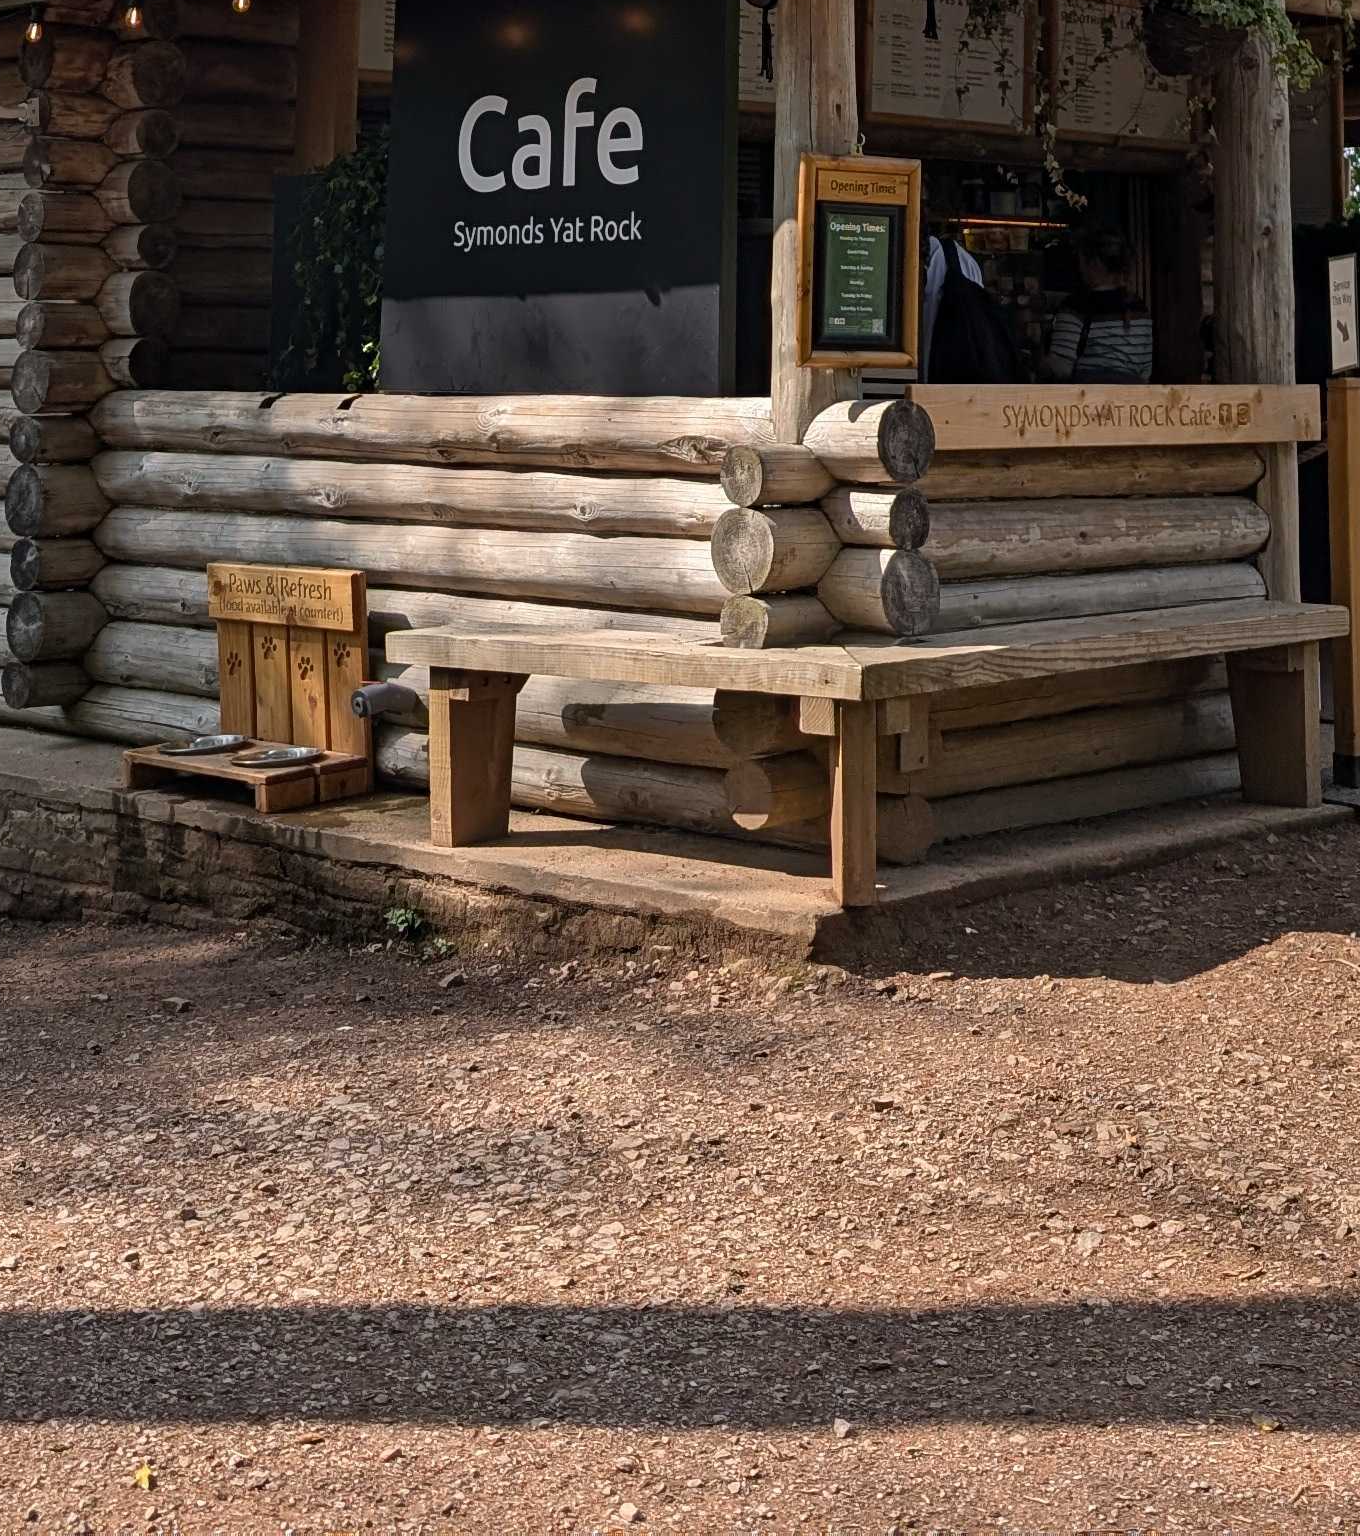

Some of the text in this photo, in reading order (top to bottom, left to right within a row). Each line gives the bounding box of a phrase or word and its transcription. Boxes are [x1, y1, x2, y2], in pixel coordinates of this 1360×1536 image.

[457, 77, 644, 193] Cafe
[830, 178, 897, 197] Opening Times
[453, 210, 642, 253] Symonds Yat Rock
[830, 222, 861, 233] Opening
[1003, 403, 1212, 428] SYMONDS YAT ROCK Café
[229, 573, 332, 601] Paws & Refresh
[246, 599, 286, 615] available
